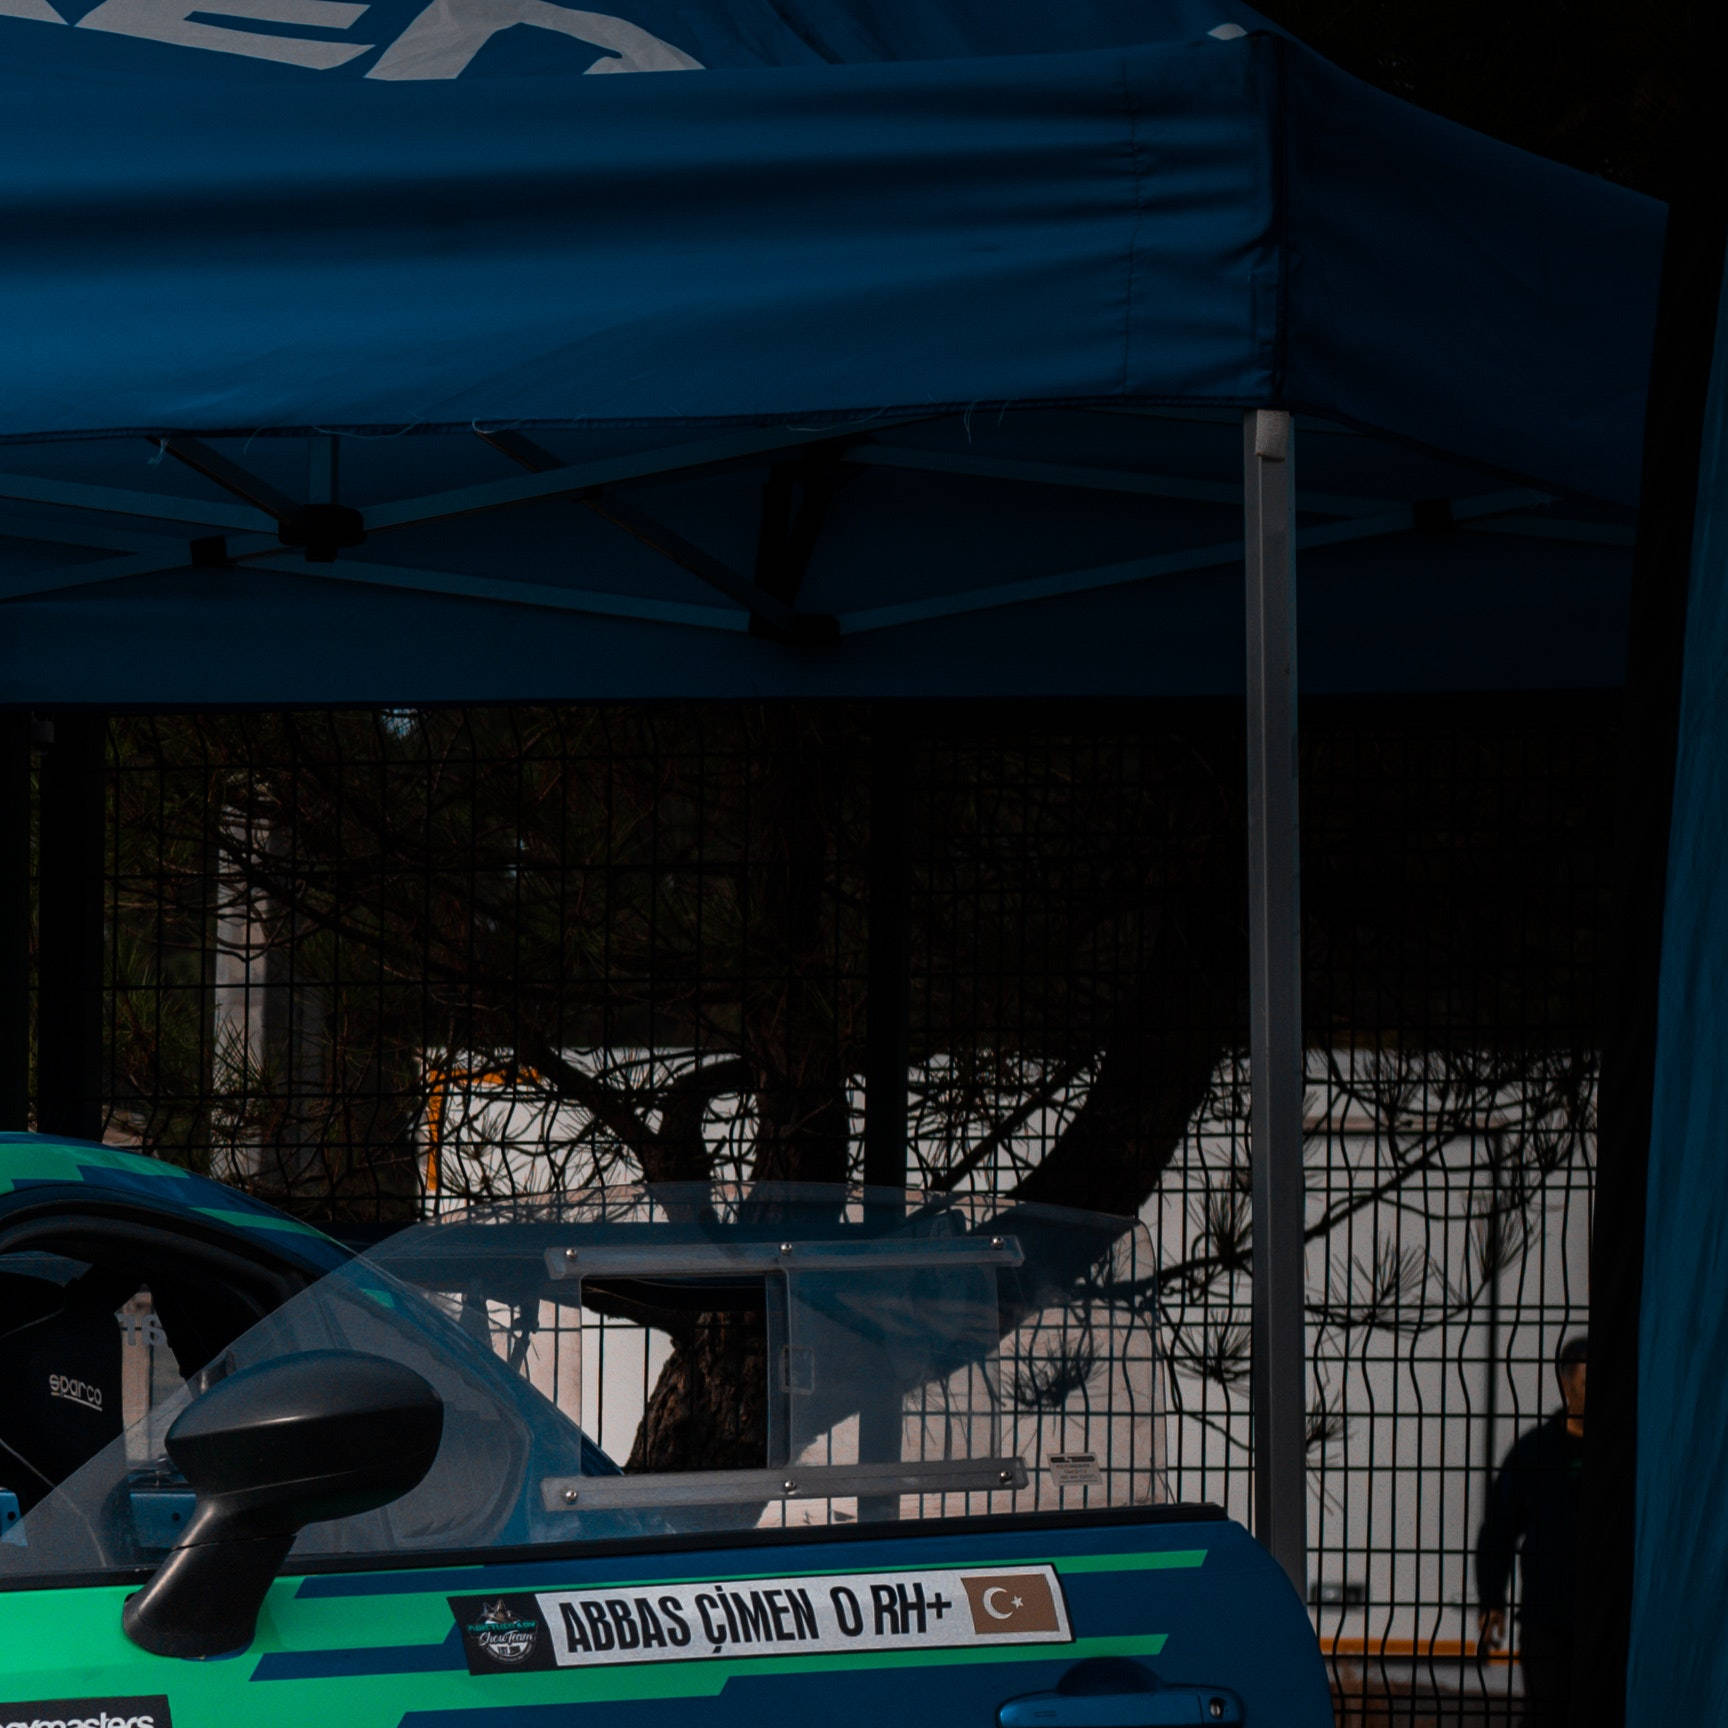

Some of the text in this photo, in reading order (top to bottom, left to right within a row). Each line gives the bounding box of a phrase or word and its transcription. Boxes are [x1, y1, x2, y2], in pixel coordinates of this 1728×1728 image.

[559, 1596, 691, 1653] ABBAS
[694, 1585, 820, 1654] ÇİMEN
[870, 1582, 953, 1636] RH+
